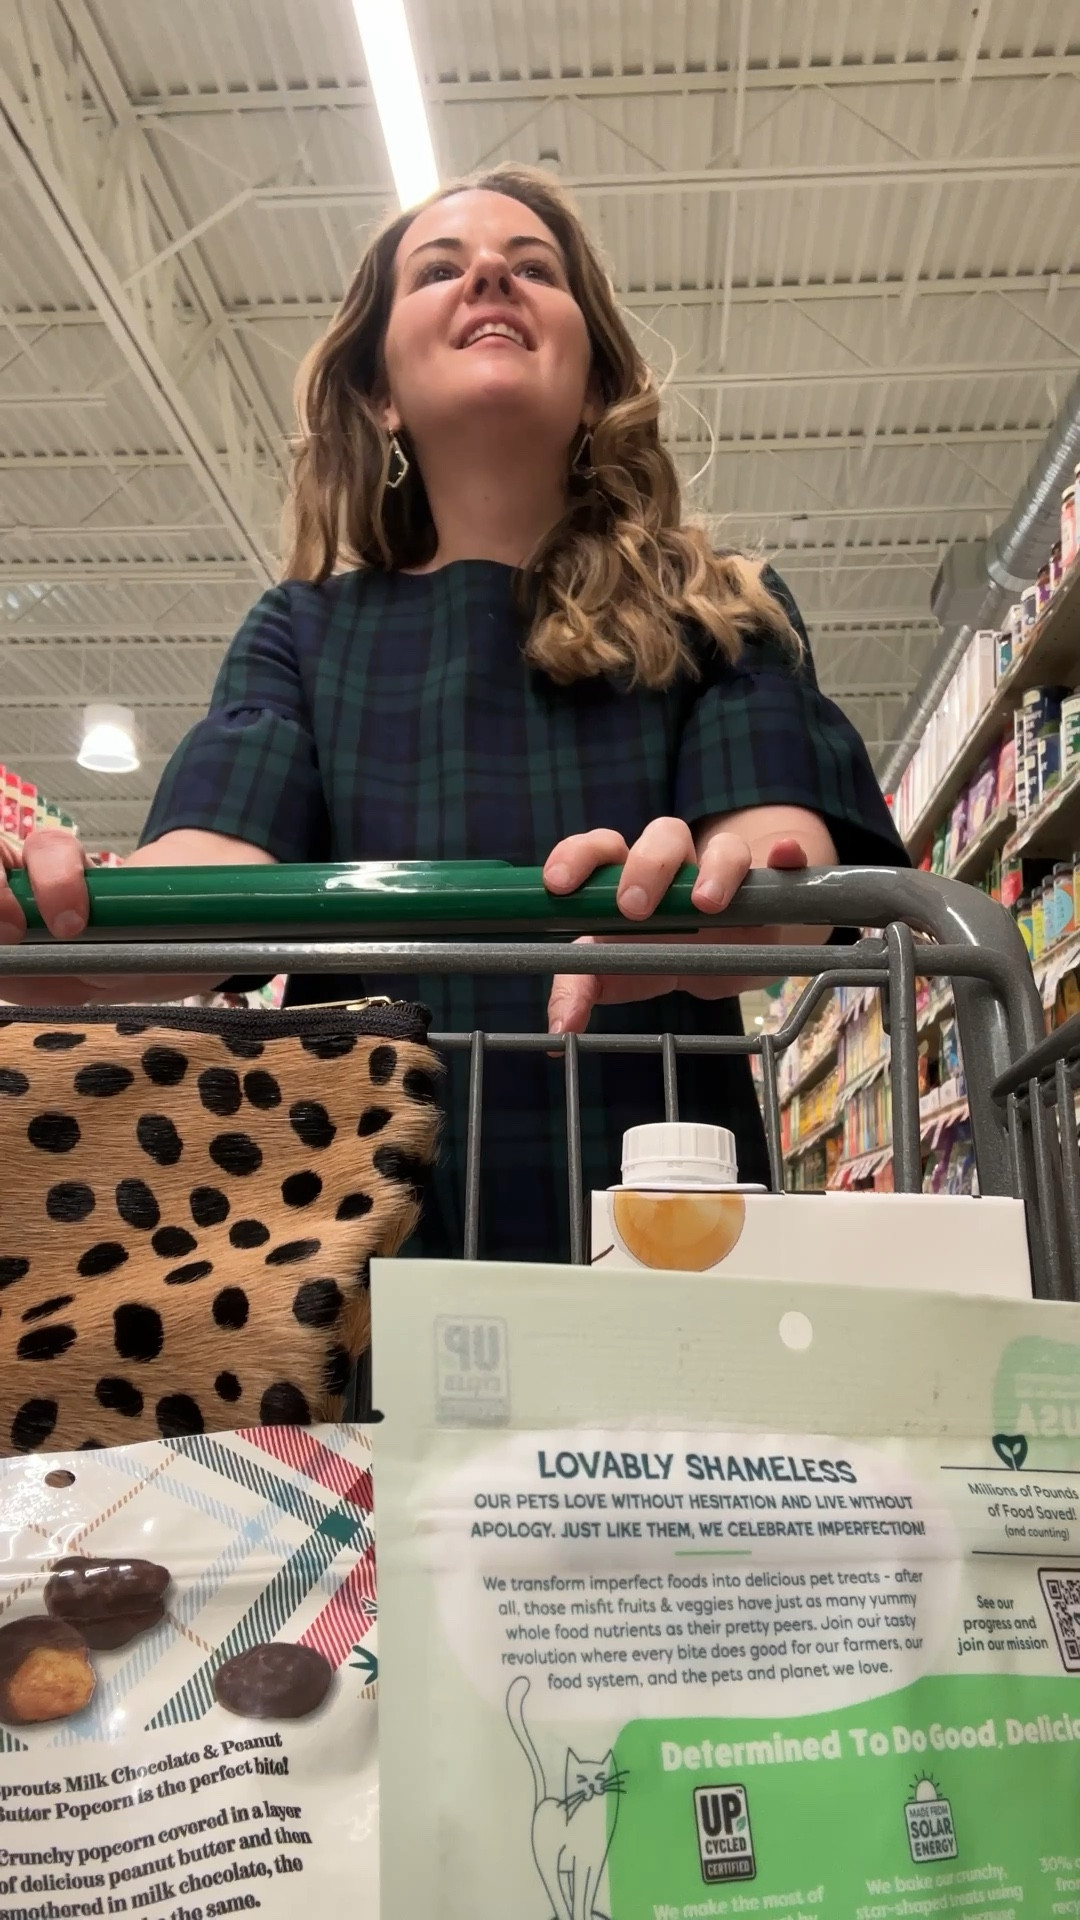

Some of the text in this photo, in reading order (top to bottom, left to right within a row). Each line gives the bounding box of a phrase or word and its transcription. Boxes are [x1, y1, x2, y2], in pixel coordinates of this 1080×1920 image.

[538, 1450, 857, 1484] LOVABLY SHAMELESS
[474, 1493, 913, 1509] OUR PETS LOVE WITHOUT HESITATION AND LIVE WITHOUT
[968, 1482, 1080, 1500] Millions of Pounds
[987, 1504, 1077, 1520] of Food Saved!
[561, 1521, 601, 1538] JUST
[606, 1521, 642, 1538] LIKE
[647, 1521, 695, 1539] THEM,
[699, 1521, 724, 1537] WE
[727, 1520, 814, 1537] CELEBRATE
[818, 1520, 926, 1536] IMPERFECTION!
[1005, 1524, 1070, 1541] (and counting)
[483, 1576, 506, 1591] We
[511, 1575, 585, 1591] transform
[590, 1574, 663, 1593] imperfect
[668, 1573, 708, 1589] foods
[712, 1573, 741, 1587] into
[745, 1571, 806, 1587] delicious
[810, 1572, 834, 1589] pet
[837, 1571, 880, 1585] treats
[894, 1568, 923, 1583] after
[524, 1600, 566, 1615] those
[571, 1599, 614, 1614] misfit
[618, 1598, 656, 1613] fruits
[660, 1597, 673, 1612] &
[676, 1597, 734, 1616] veggies
[738, 1595, 772, 1611] have
[774, 1594, 802, 1613] just
[806, 1597, 822, 1608] as
[826, 1595, 866, 1608] many
[869, 1593, 917, 1608] yummy
[977, 1595, 1014, 1609] See our
[506, 1614, 916, 1640] whole food nutrients as their pretty peers. Join our tasty
[963, 1616, 1037, 1633] progress and
[501, 1649, 577, 1665] revolution
[580, 1648, 627, 1663] where
[631, 1649, 673, 1665] every
[677, 1644, 707, 1660] bite
[711, 1643, 746, 1658] does
[751, 1641, 787, 1660] good
[791, 1640, 811, 1654] for
[815, 1641, 839, 1653] our
[905, 1637, 923, 1649] our
[957, 1636, 1049, 1656] join our mission
[548, 1660, 893, 1691] food system, and the pets and planet we love.
[661, 1729, 841, 1772] Determined
[850, 1728, 889, 1757] To
[892, 1726, 927, 1753] Do
[0, 1732, 282, 1801] prouts Milk Chocolate & Peanut
[55, 1794, 134, 1820] Popcorn
[138, 1788, 153, 1803] is
[157, 1780, 186, 1798] the
[189, 1760, 252, 1793] perfect
[253, 1756, 289, 1775] bite!
[700, 1793, 742, 1837] UP
[0, 1800, 302, 1867] Crunchy popcorn covered in a layer
[911, 1817, 953, 1839] SOLAR
[705, 1837, 747, 1855] CYCLED
[915, 1838, 954, 1857] ENERGY
[0, 1826, 312, 1895] of delicious peanut butter and then
[708, 1860, 750, 1877] CERTIFIED
[0, 1854, 303, 1920] smothered in milk chocolate, the
[865, 1879, 891, 1895] We
[895, 1874, 933, 1893] bake
[935, 1873, 953, 1887] our
[205, 1893, 261, 1918] same.
[653, 1885, 825, 1920] We make the most of
[856, 1883, 1023, 1920] star-shaped treats using
